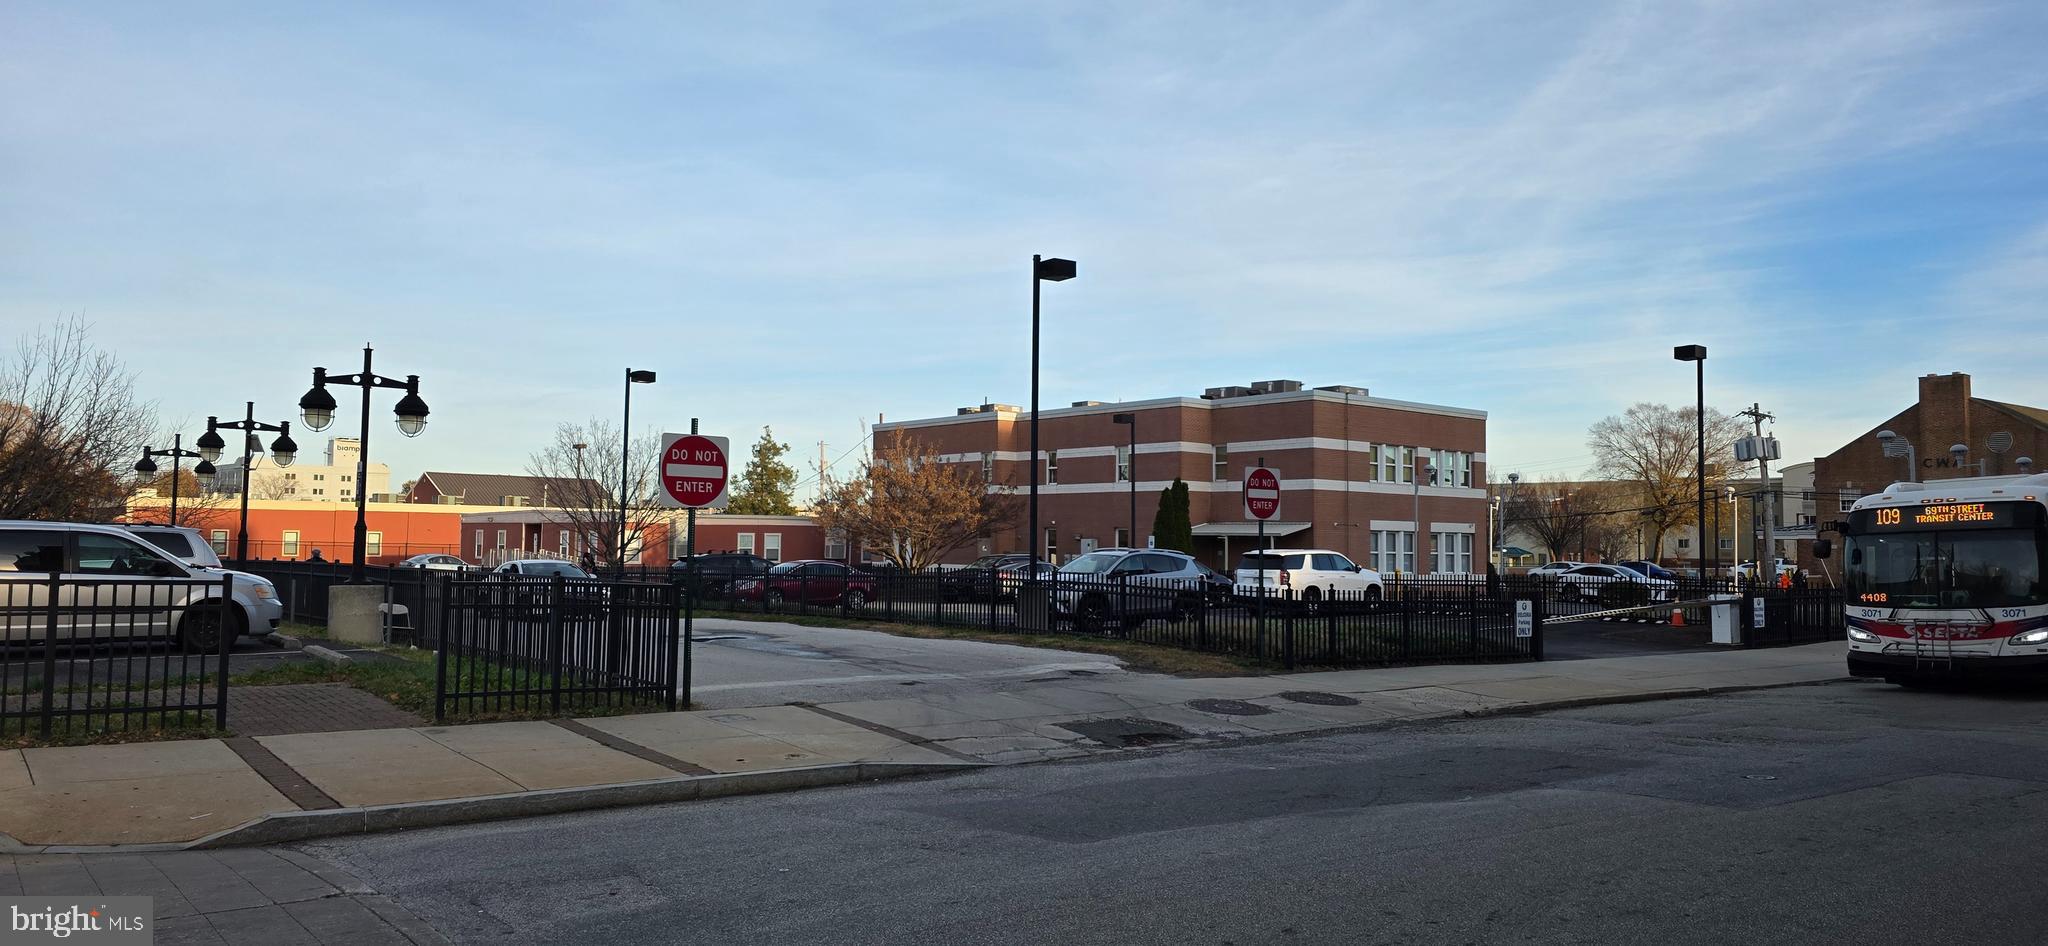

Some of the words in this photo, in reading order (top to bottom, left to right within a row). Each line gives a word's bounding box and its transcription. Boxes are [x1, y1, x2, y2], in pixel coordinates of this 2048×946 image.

[672, 448, 688, 460] DO
[695, 450, 718, 462] NOT
[676, 481, 713, 492] ENTER
[1250, 478, 1259, 487] DO
[1262, 479, 1275, 487] NOT
[1253, 501, 1272, 509] ENTER
[1925, 505, 1949, 515] 69TH
[1950, 503, 1984, 514] STREET
[1876, 508, 1900, 525] 109
[1915, 514, 1954, 523] TRANSIT
[1957, 511, 1994, 521] CENTER
[1860, 593, 1887, 602] 4408
[1861, 608, 1882, 618] 3071
[2002, 608, 2026, 618] 3071
[1923, 626, 1978, 638] SEPTA
